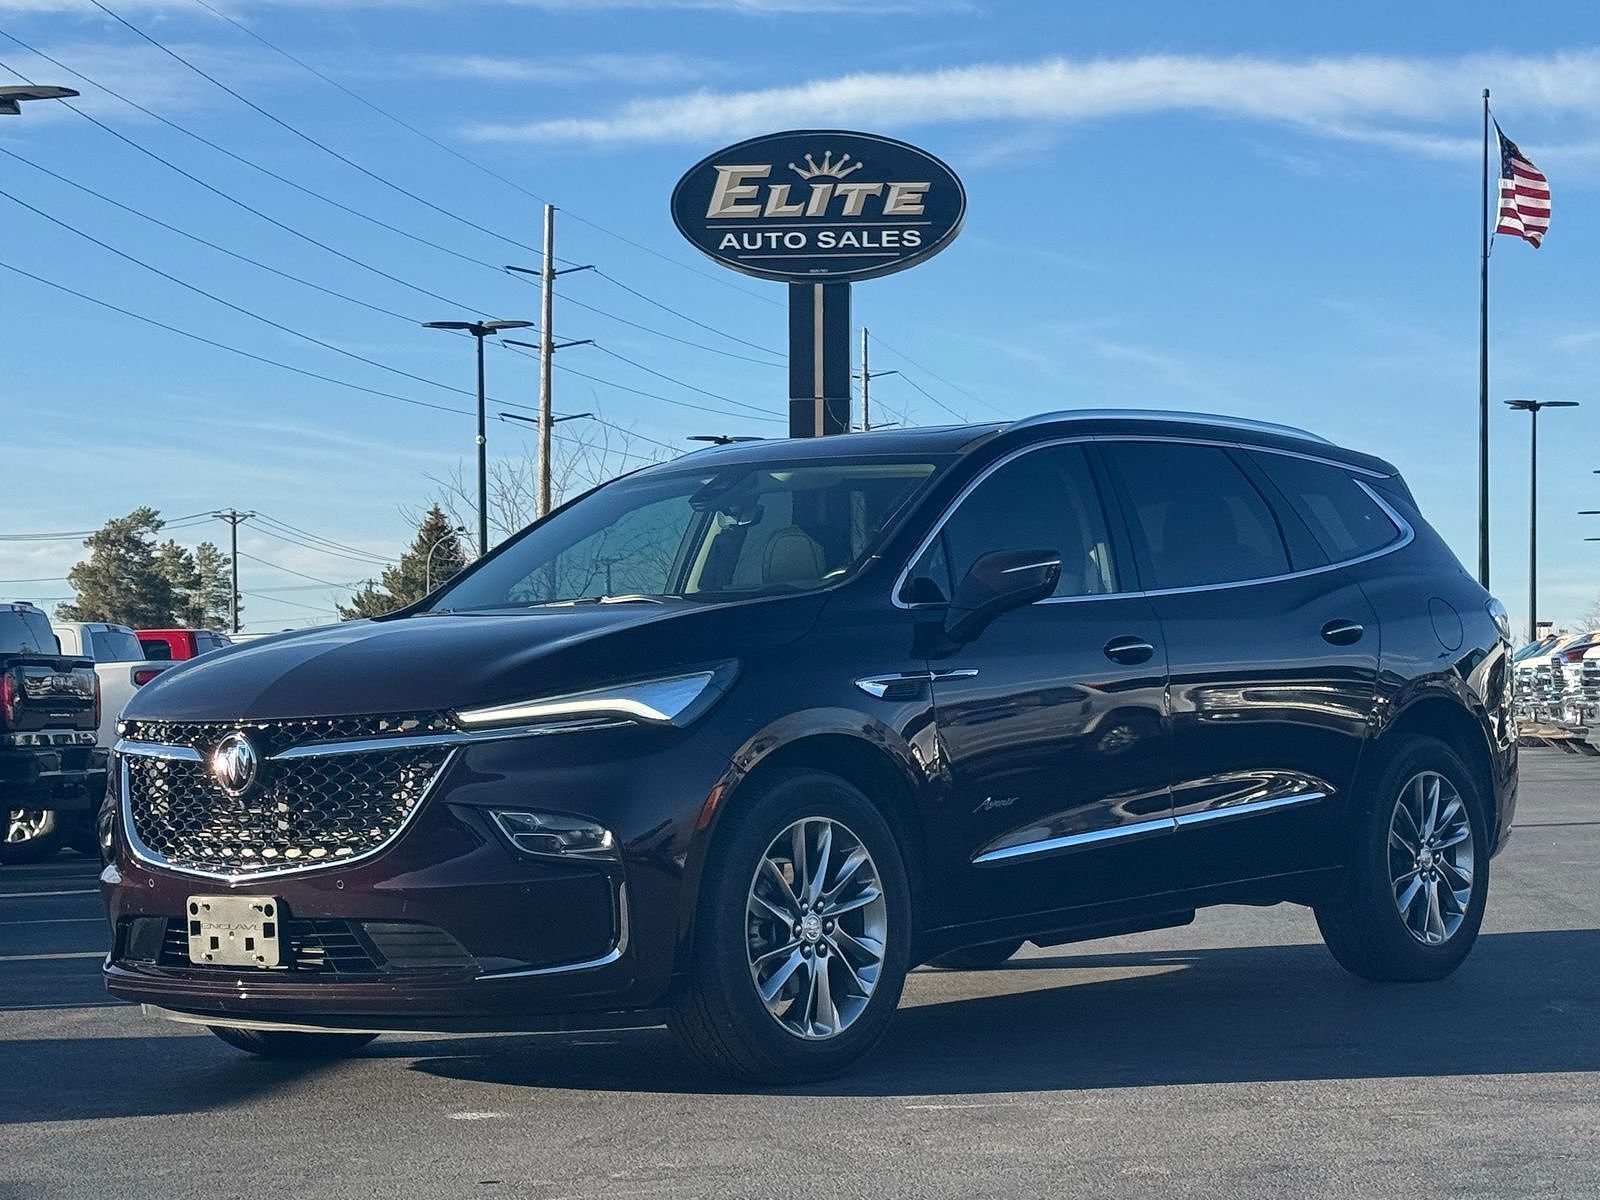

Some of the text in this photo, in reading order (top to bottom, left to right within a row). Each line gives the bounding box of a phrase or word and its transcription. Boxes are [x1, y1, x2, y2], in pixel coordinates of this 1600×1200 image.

[705, 164, 931, 219] ELITE
[718, 229, 921, 250] AUTO SALES
